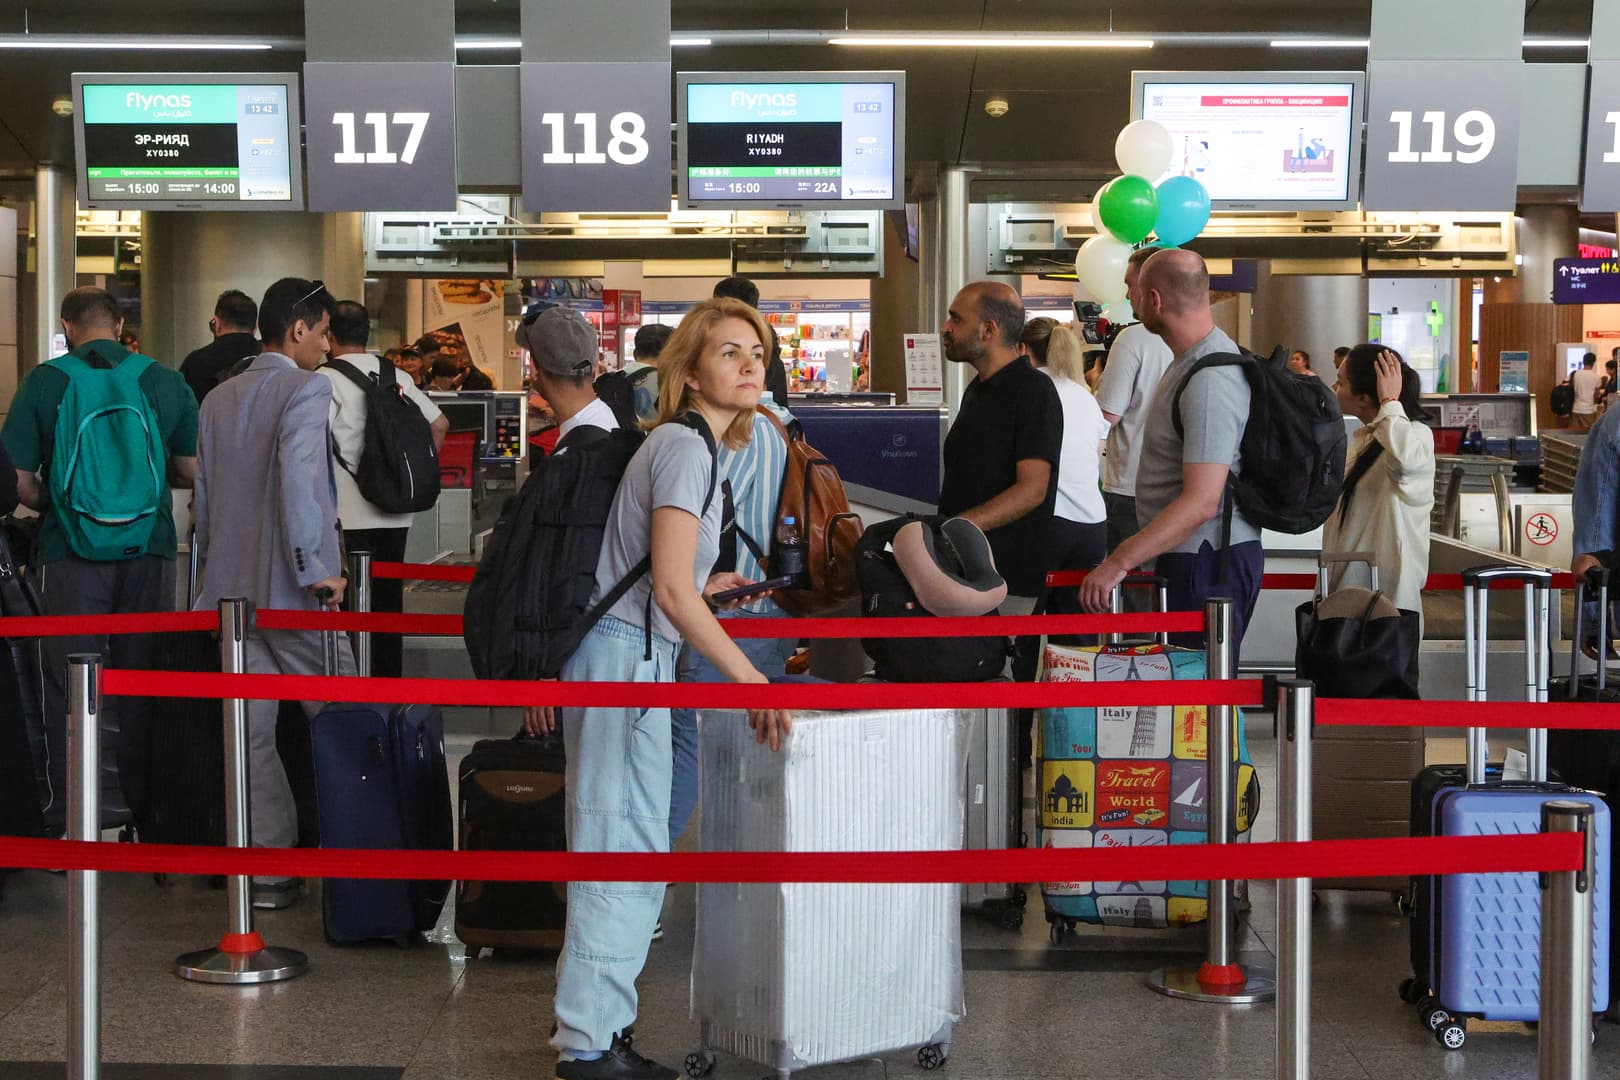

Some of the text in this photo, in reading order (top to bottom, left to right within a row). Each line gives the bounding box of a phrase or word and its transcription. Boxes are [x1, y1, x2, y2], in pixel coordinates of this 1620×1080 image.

[126, 91, 192, 111] flynas
[731, 91, 797, 110] flynas
[134, 134, 190, 146] ЭР-РИЯД
[332, 112, 430, 164] 117
[542, 111, 649, 165] 118
[746, 133, 784, 144] RIYADH
[1388, 110, 1496, 164] 119
[128, 183, 160, 194] 15:00
[203, 183, 235, 194] 14:00
[729, 183, 760, 193] 15:00
[814, 182, 837, 193] 22A
[1570, 267, 1600, 276] Туалет
[1103, 707, 1132, 719] Italy
[1072, 743, 1092, 754] Tour
[1101, 769, 1165, 788] Travel
[1110, 796, 1155, 807] World
[1051, 816, 1074, 825] India
[1100, 810, 1129, 822] It's Fun!
[1183, 811, 1208, 823] Egyp
[1101, 833, 1126, 848] Pari
[1103, 906, 1130, 916] Italy
